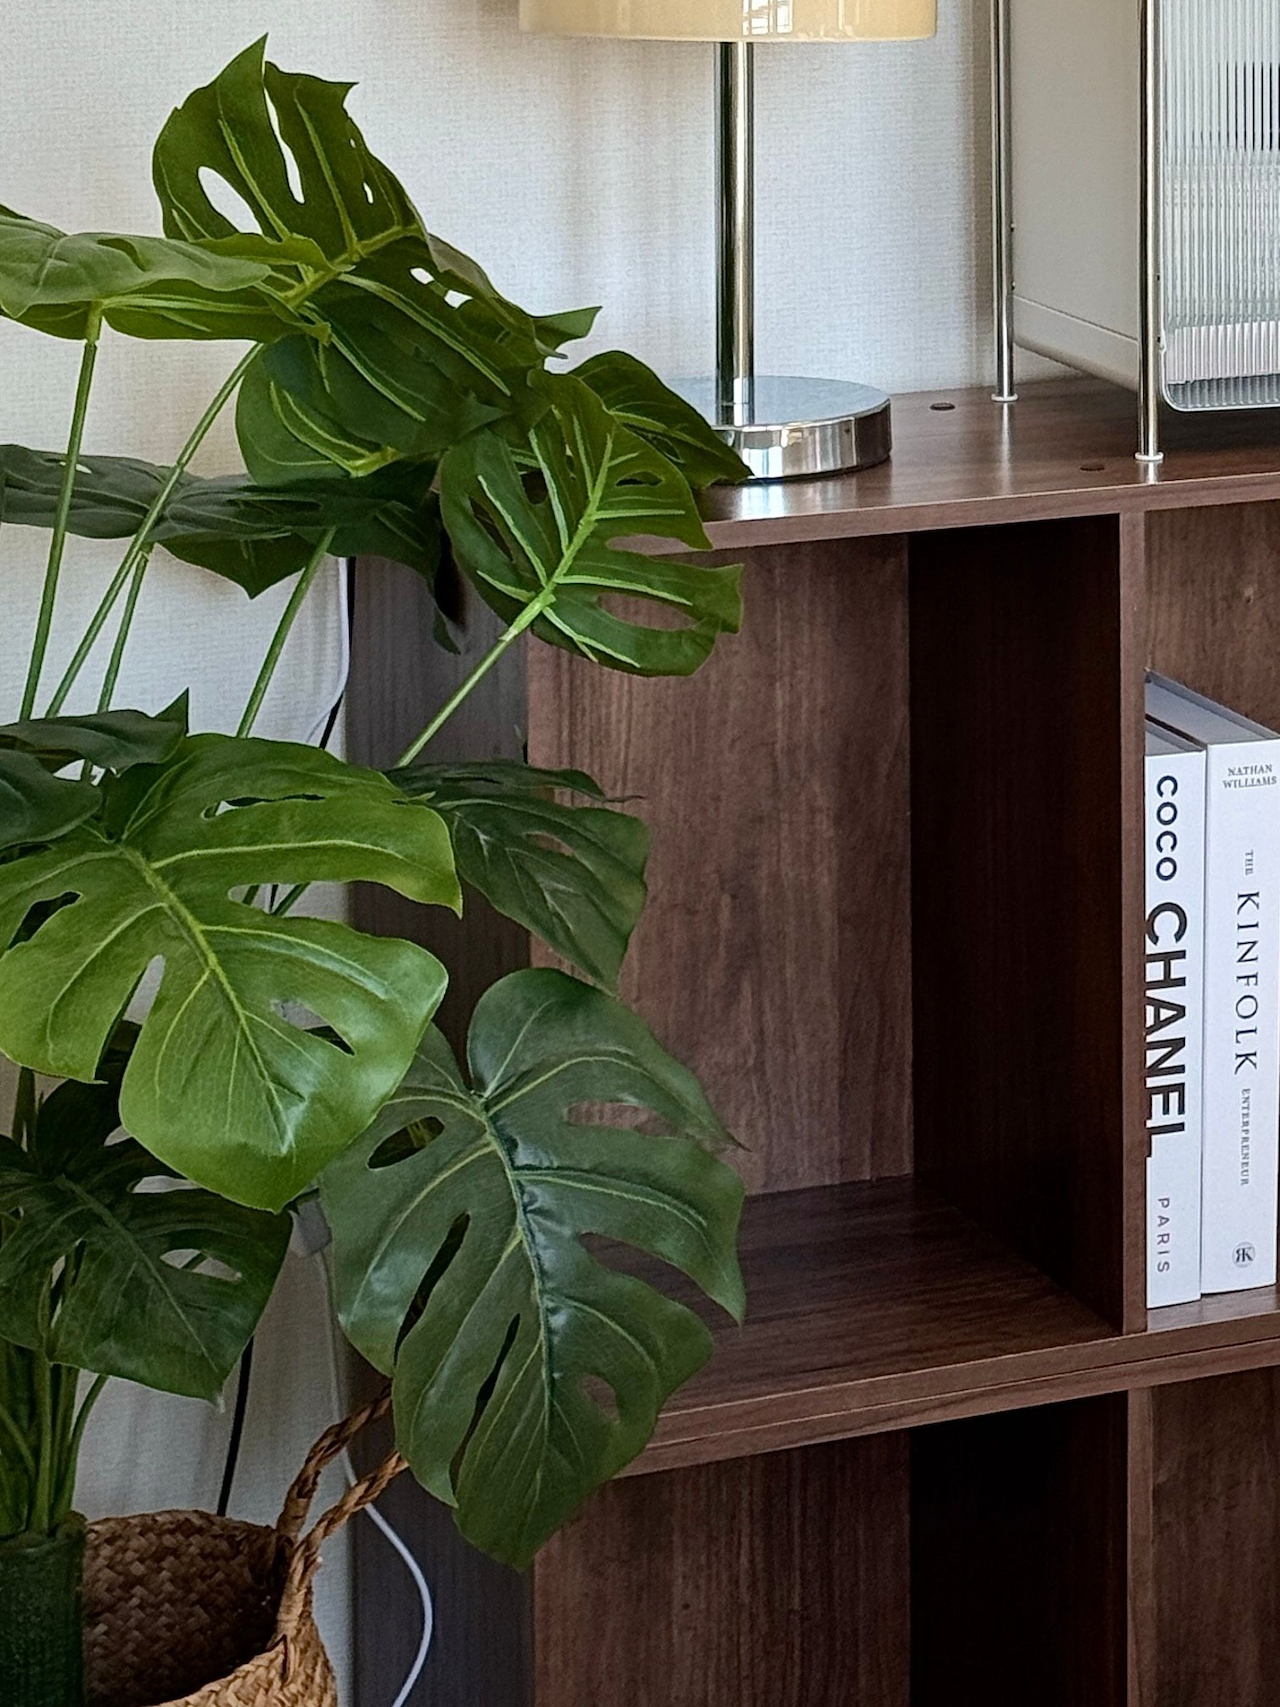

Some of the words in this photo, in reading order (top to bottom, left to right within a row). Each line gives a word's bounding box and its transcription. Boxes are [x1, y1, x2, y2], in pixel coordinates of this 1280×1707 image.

[1222, 776, 1277, 789] WILLIAMS
[1227, 764, 1273, 776] NATHAN
[1156, 775, 1178, 882] COCO
[1244, 849, 1254, 876] THE
[1234, 891, 1260, 1076] KINFOLK
[1145, 902, 1187, 1158] CHANEL
[1156, 1197, 1170, 1273] PARIS
